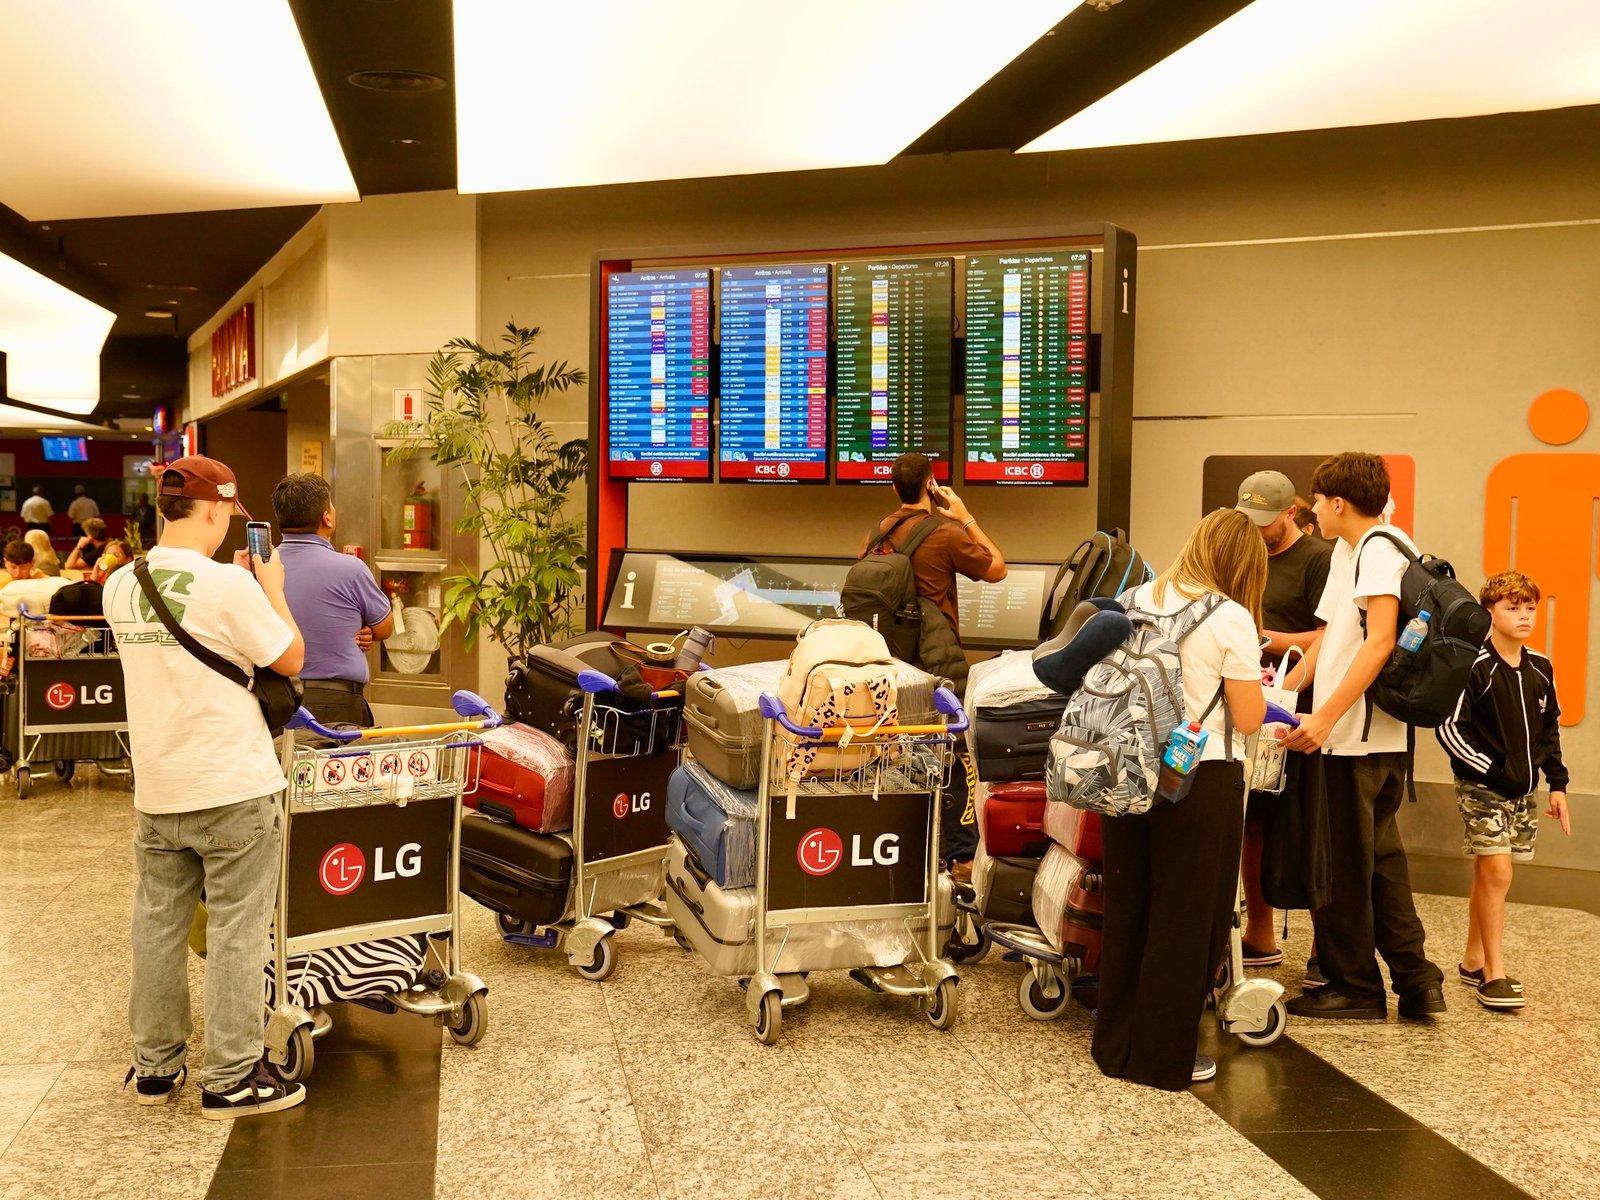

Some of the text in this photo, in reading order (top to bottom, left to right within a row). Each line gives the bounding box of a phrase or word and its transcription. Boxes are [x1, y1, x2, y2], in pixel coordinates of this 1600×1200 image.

[755, 465, 776, 474] ICBC
[1005, 466, 1028, 476] ICBC
[81, 685, 113, 704] LG
[1172, 746, 1189, 762] Tutti
[632, 792, 650, 813] LG
[852, 833, 900, 866] LG
[374, 843, 422, 881] LG
